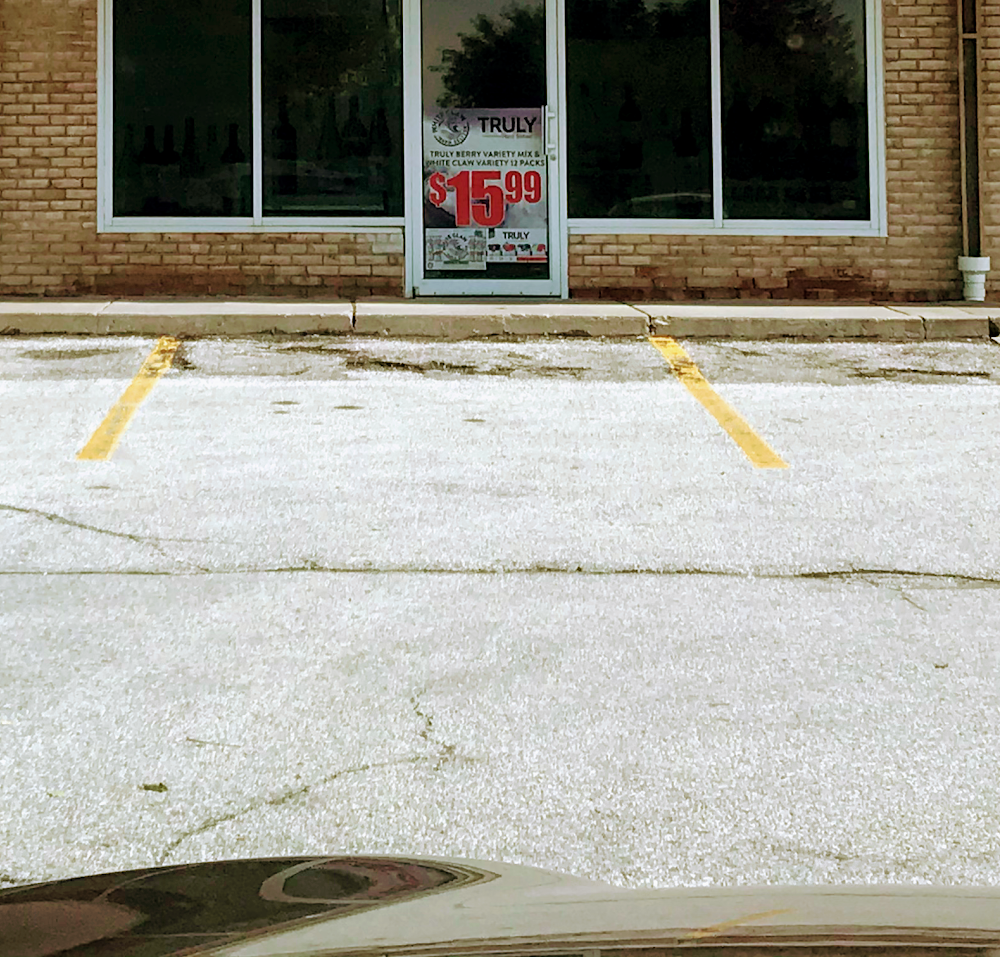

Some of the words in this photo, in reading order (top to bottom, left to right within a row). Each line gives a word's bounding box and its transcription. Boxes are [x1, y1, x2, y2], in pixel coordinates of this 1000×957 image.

[477, 116, 537, 133] TRULY
[426, 159, 450, 167] WHITE
[452, 159, 475, 167] CLAW
[476, 159, 509, 167] VARIETY
[510, 159, 518, 167] 12
[519, 159, 545, 167] PACKS
[502, 231, 530, 240] TRULY
